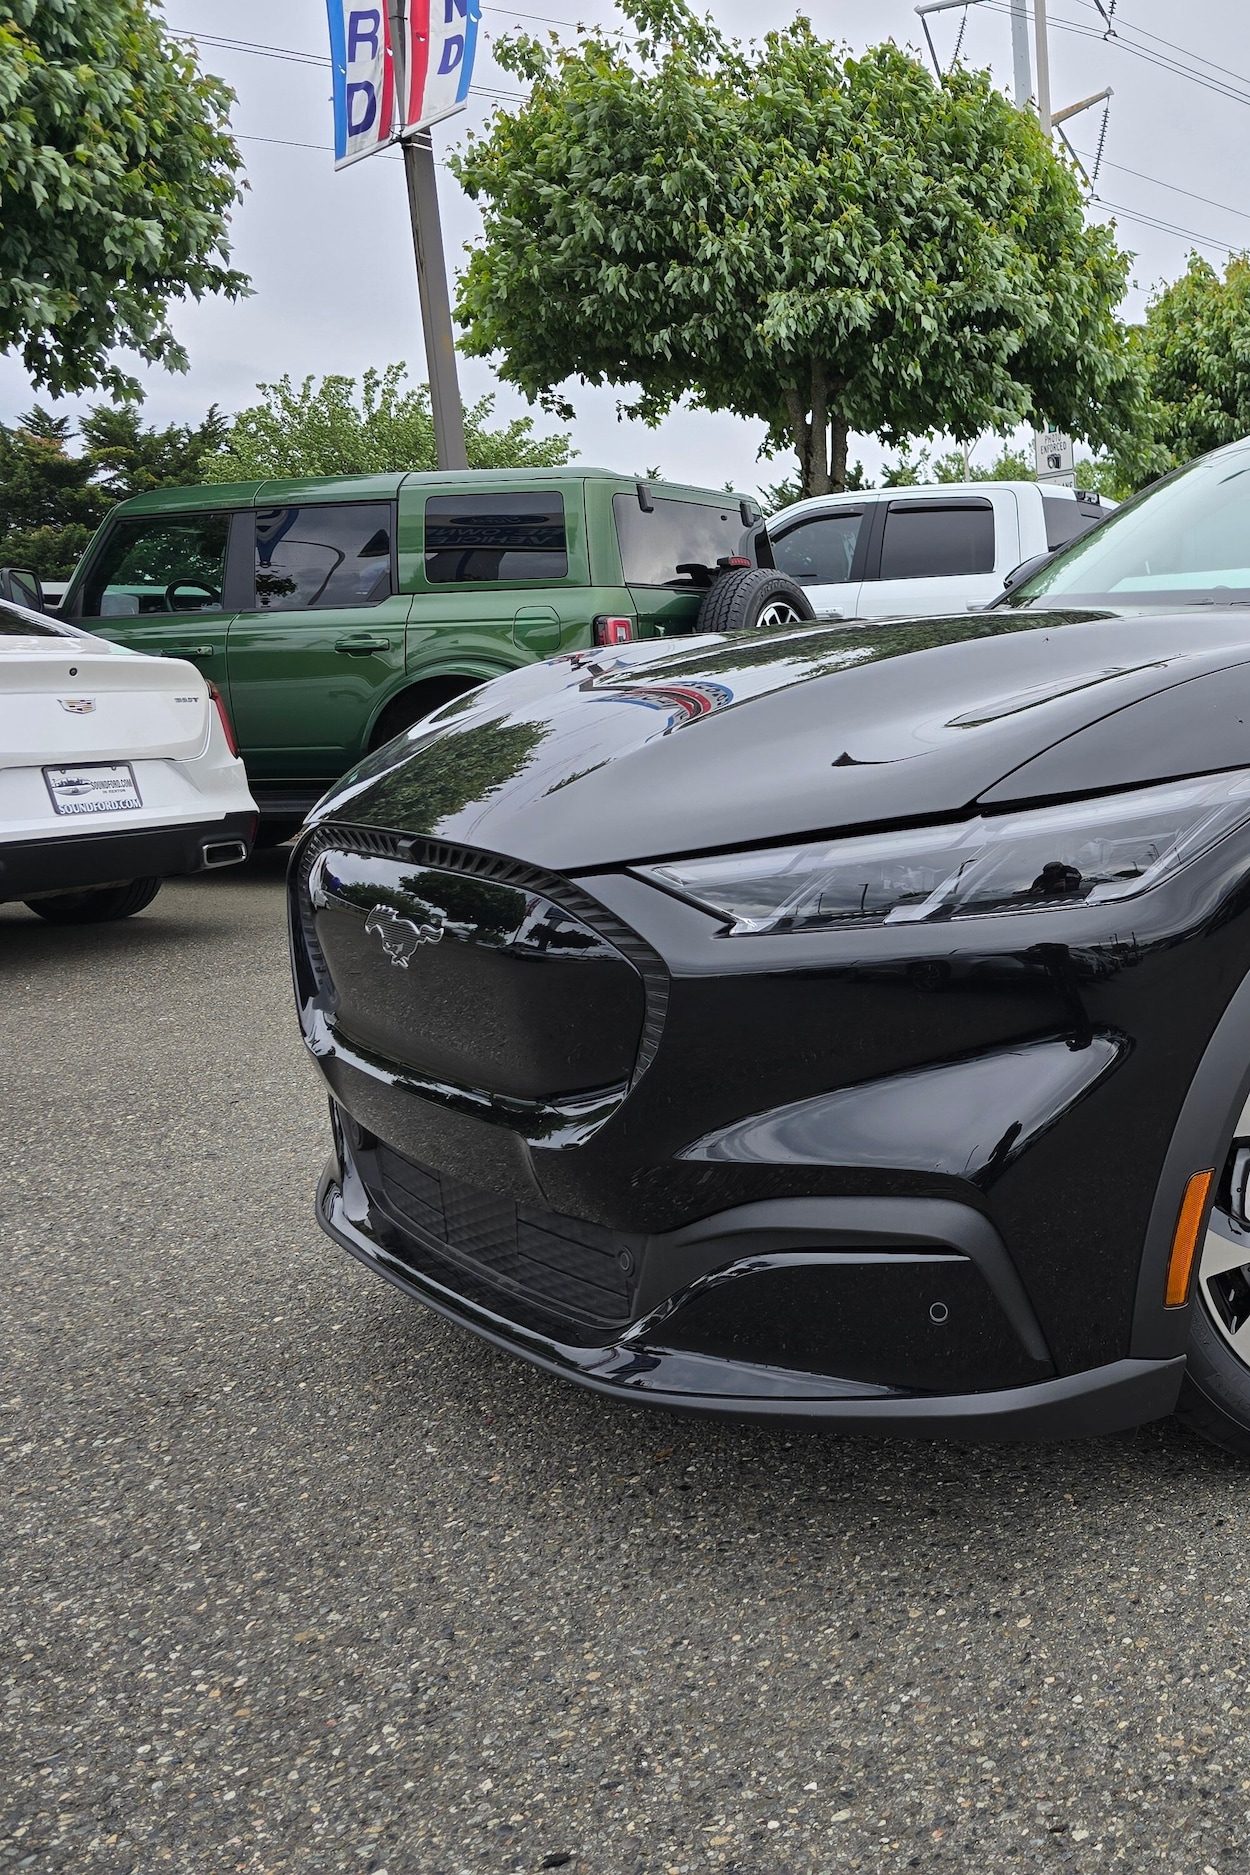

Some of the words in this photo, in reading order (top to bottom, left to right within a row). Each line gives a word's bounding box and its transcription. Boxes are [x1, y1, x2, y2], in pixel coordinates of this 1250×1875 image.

[1041, 441, 1067, 454] ENFORCED
[91, 778, 133, 791] SOUNDFORD.COM
[59, 799, 142, 815] SOUNDFORD.COM
